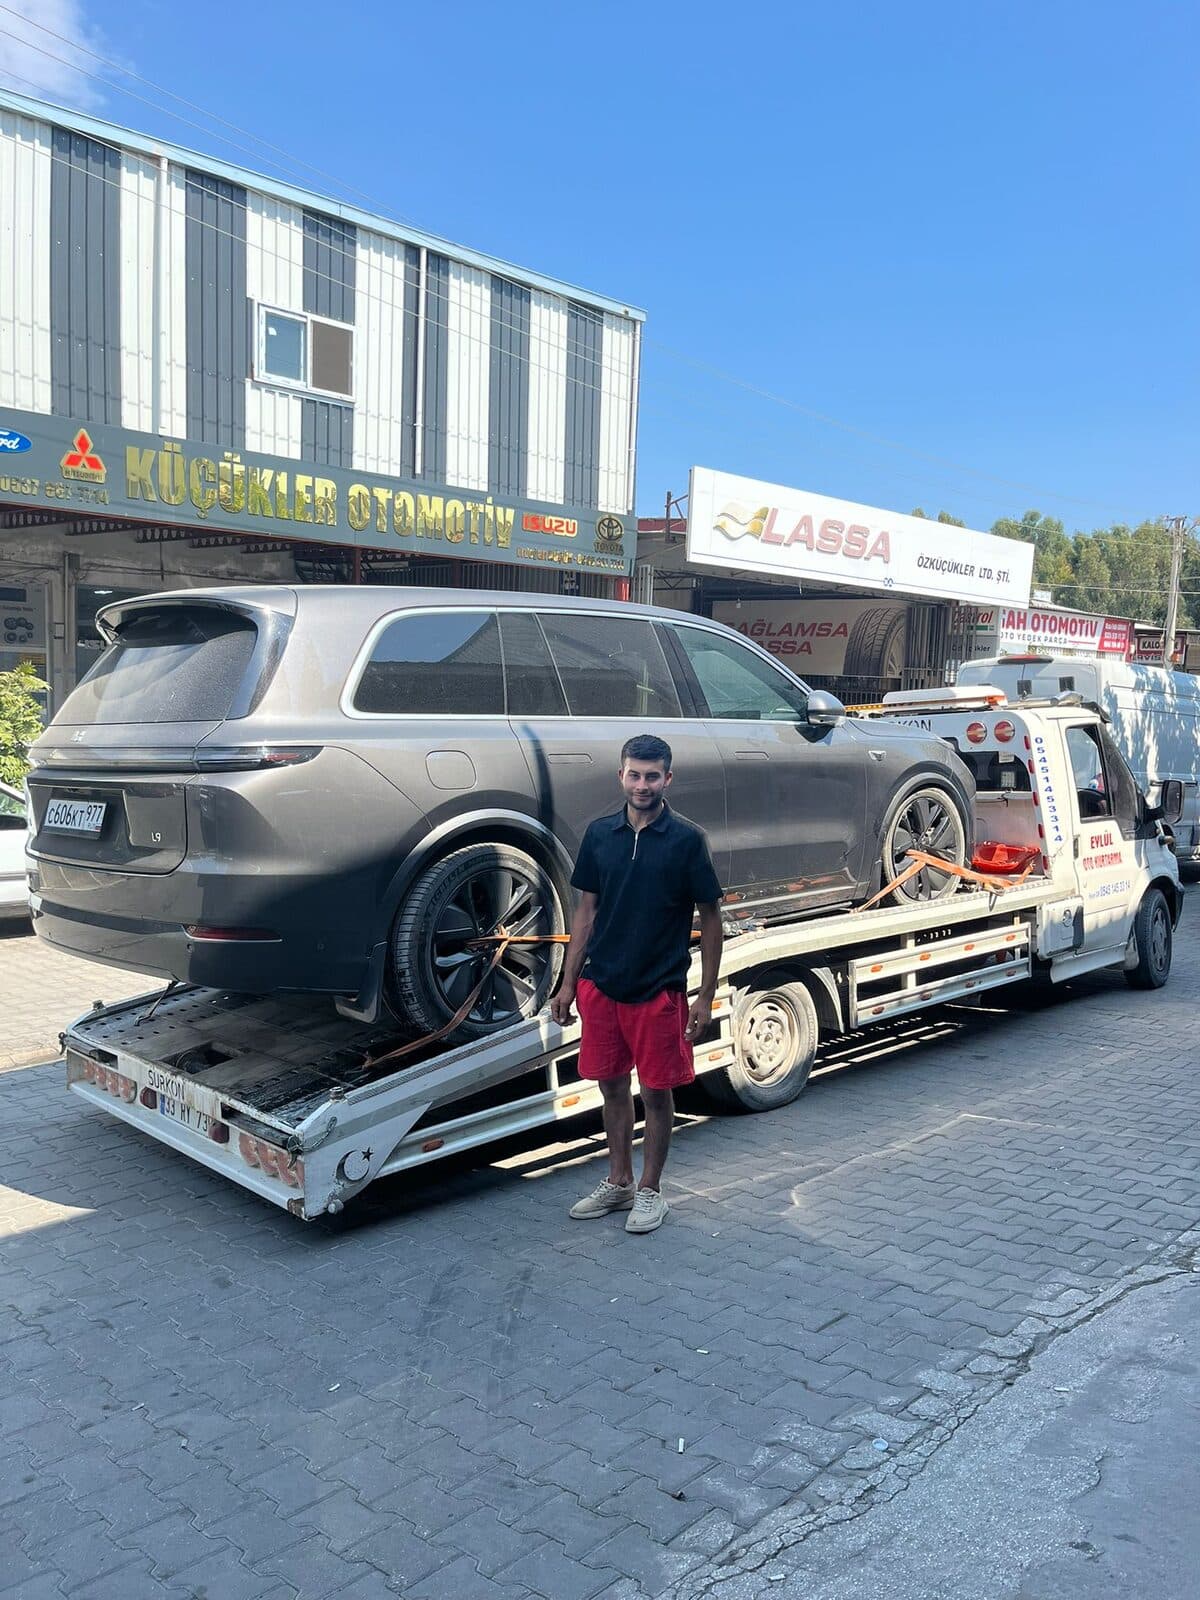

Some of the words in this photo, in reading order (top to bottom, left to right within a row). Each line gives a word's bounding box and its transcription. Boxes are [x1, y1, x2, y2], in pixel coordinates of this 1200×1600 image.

[0, 431, 20, 449] ord
[126, 441, 337, 526] KÜÇÜKLER
[348, 484, 515, 548] OTOMOTİV
[522, 513, 577, 536] ISUZU
[761, 508, 891, 564] LASSA
[917, 552, 975, 577] ÖZKÜÇÜKLER
[979, 567, 994, 580] LTD.
[1017, 633, 1042, 642] YEDEK
[1031, 613, 1098, 638] OTOMOTİV
[151, 832, 161, 842] L9
